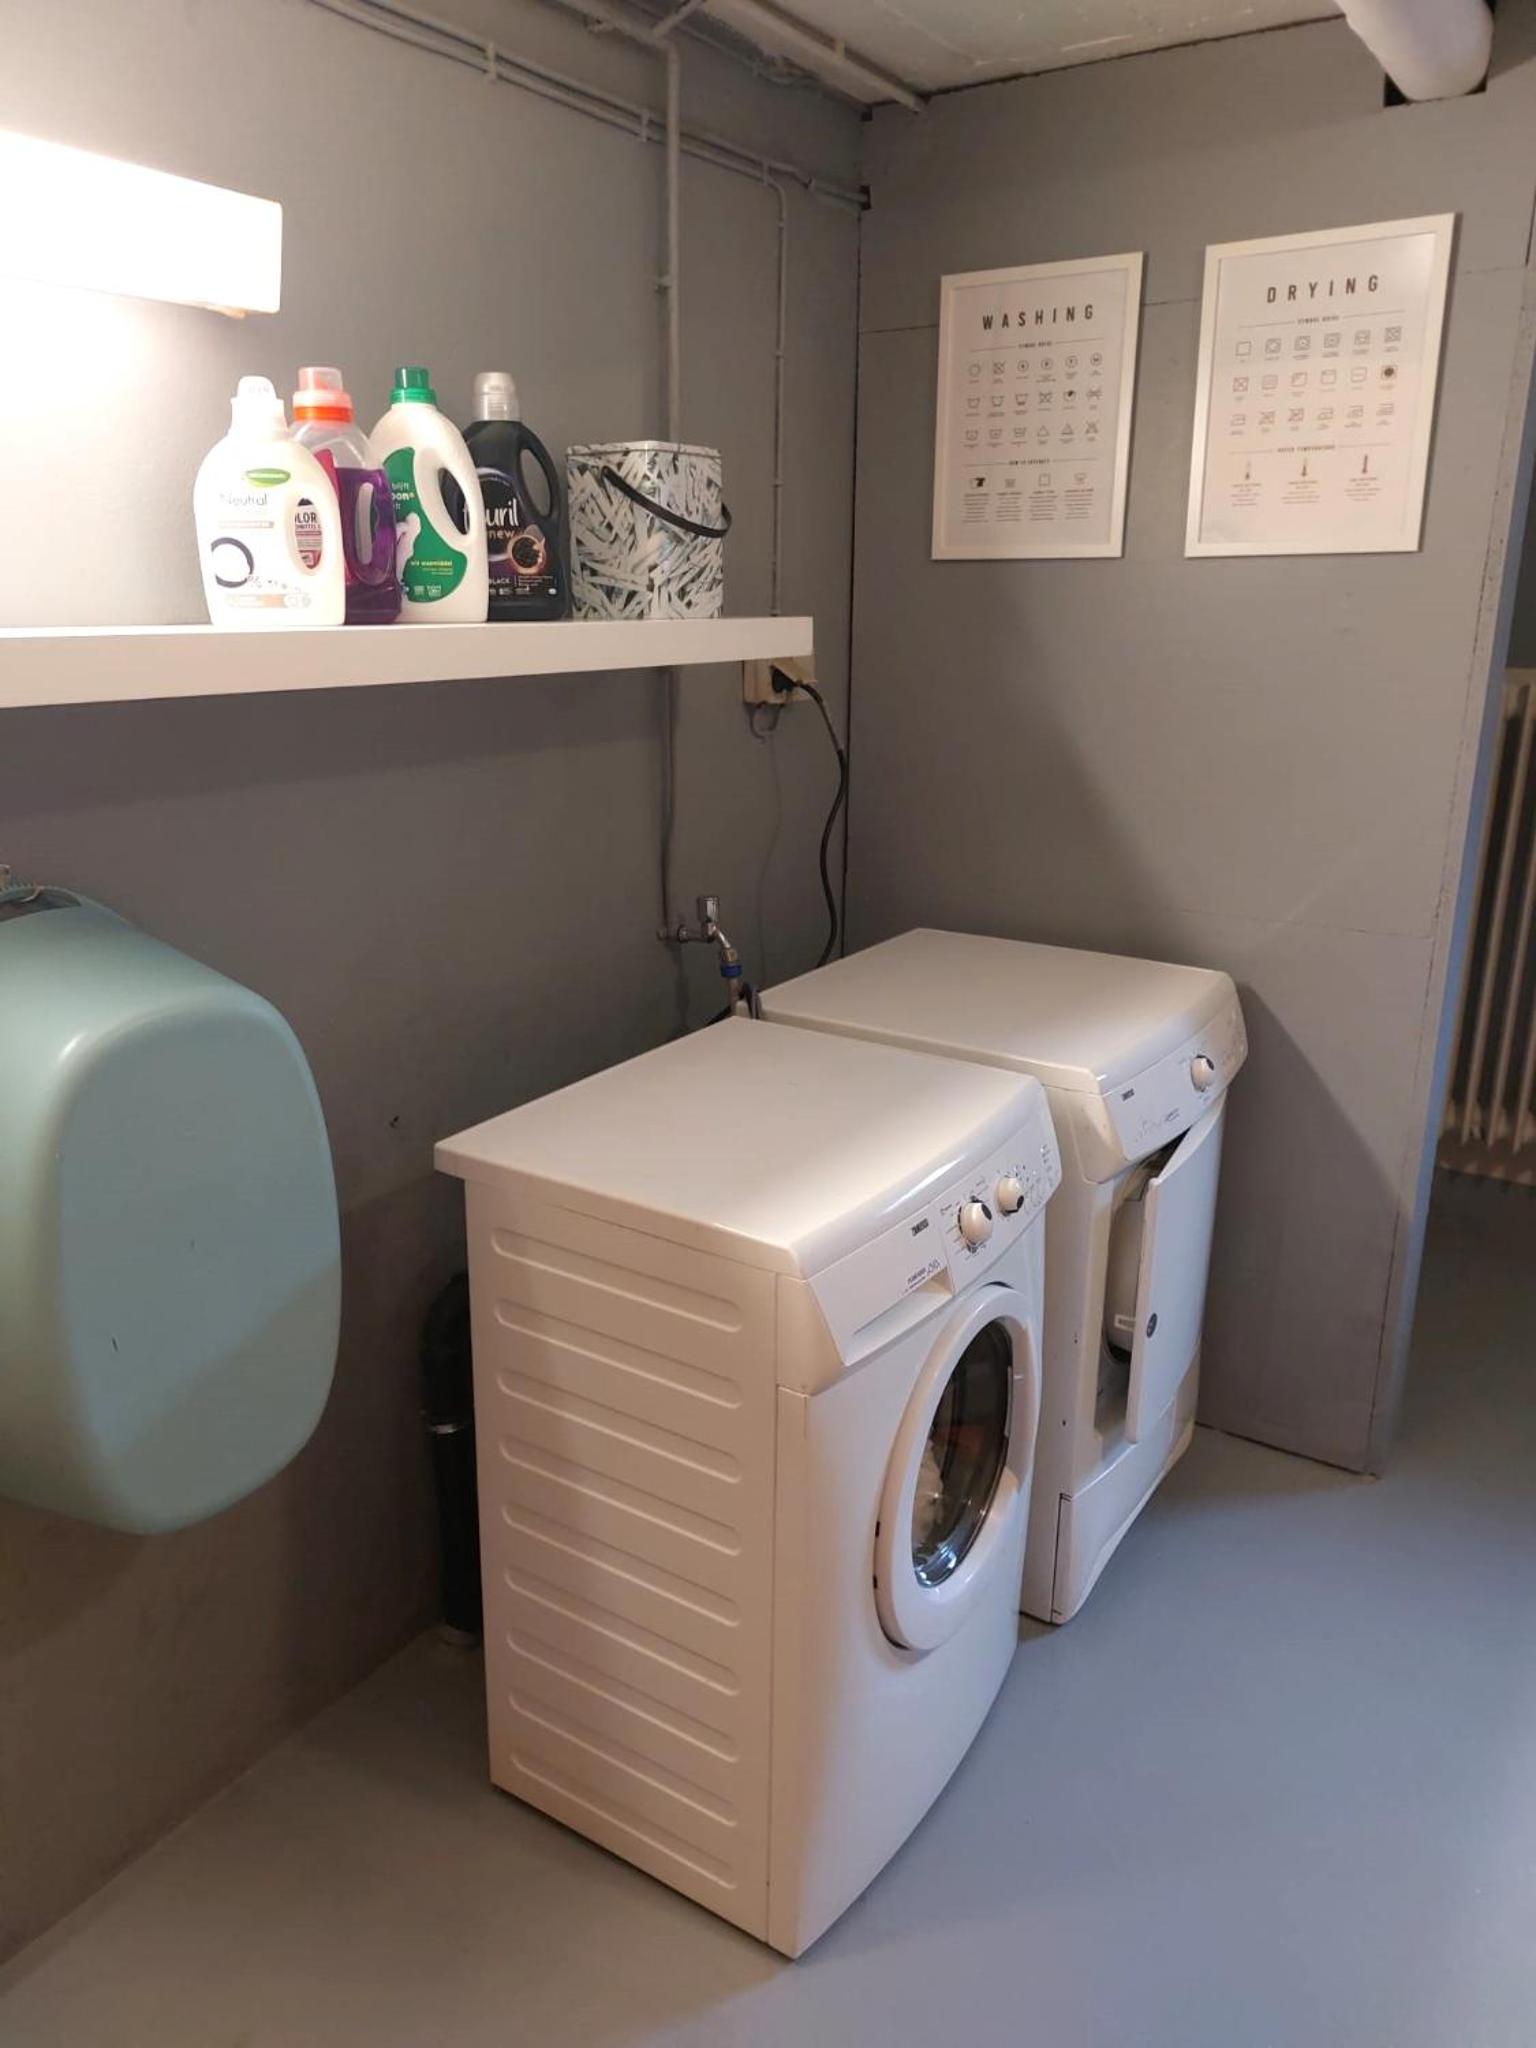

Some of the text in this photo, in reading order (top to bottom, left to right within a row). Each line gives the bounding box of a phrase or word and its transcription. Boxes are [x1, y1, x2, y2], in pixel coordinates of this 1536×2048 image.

[1266, 274, 1379, 304] DRYING
[982, 304, 1094, 331] WASHING
[294, 511, 318, 524] LOR
[485, 497, 519, 527] uril
[488, 529, 515, 540] new
